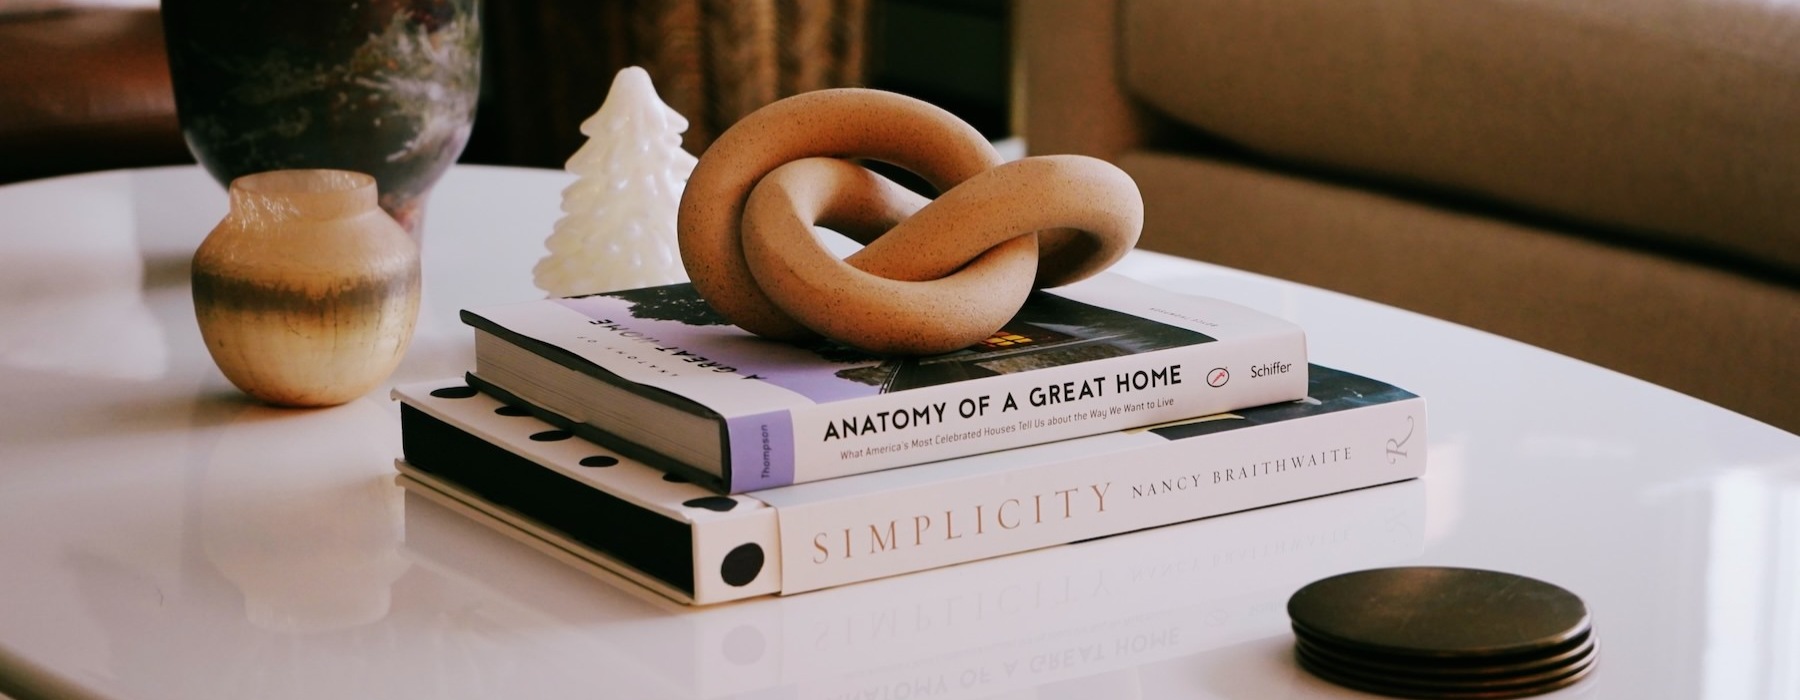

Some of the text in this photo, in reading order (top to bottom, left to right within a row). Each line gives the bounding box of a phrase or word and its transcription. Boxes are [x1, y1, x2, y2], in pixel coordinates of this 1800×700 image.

[654, 346, 738, 373] GREAT
[1250, 362, 1292, 379] Schiffer
[823, 364, 1182, 441] ANATOMY OF A GREAT HOME
[840, 397, 1174, 460] What America's Most Celebrated Houses Tell Us about the Way We Want to Live
[760, 424, 772, 479] Thompson
[1132, 447, 1352, 499] NANCY BRAITHWAITE
[812, 482, 1111, 564] SIMPLICITY
